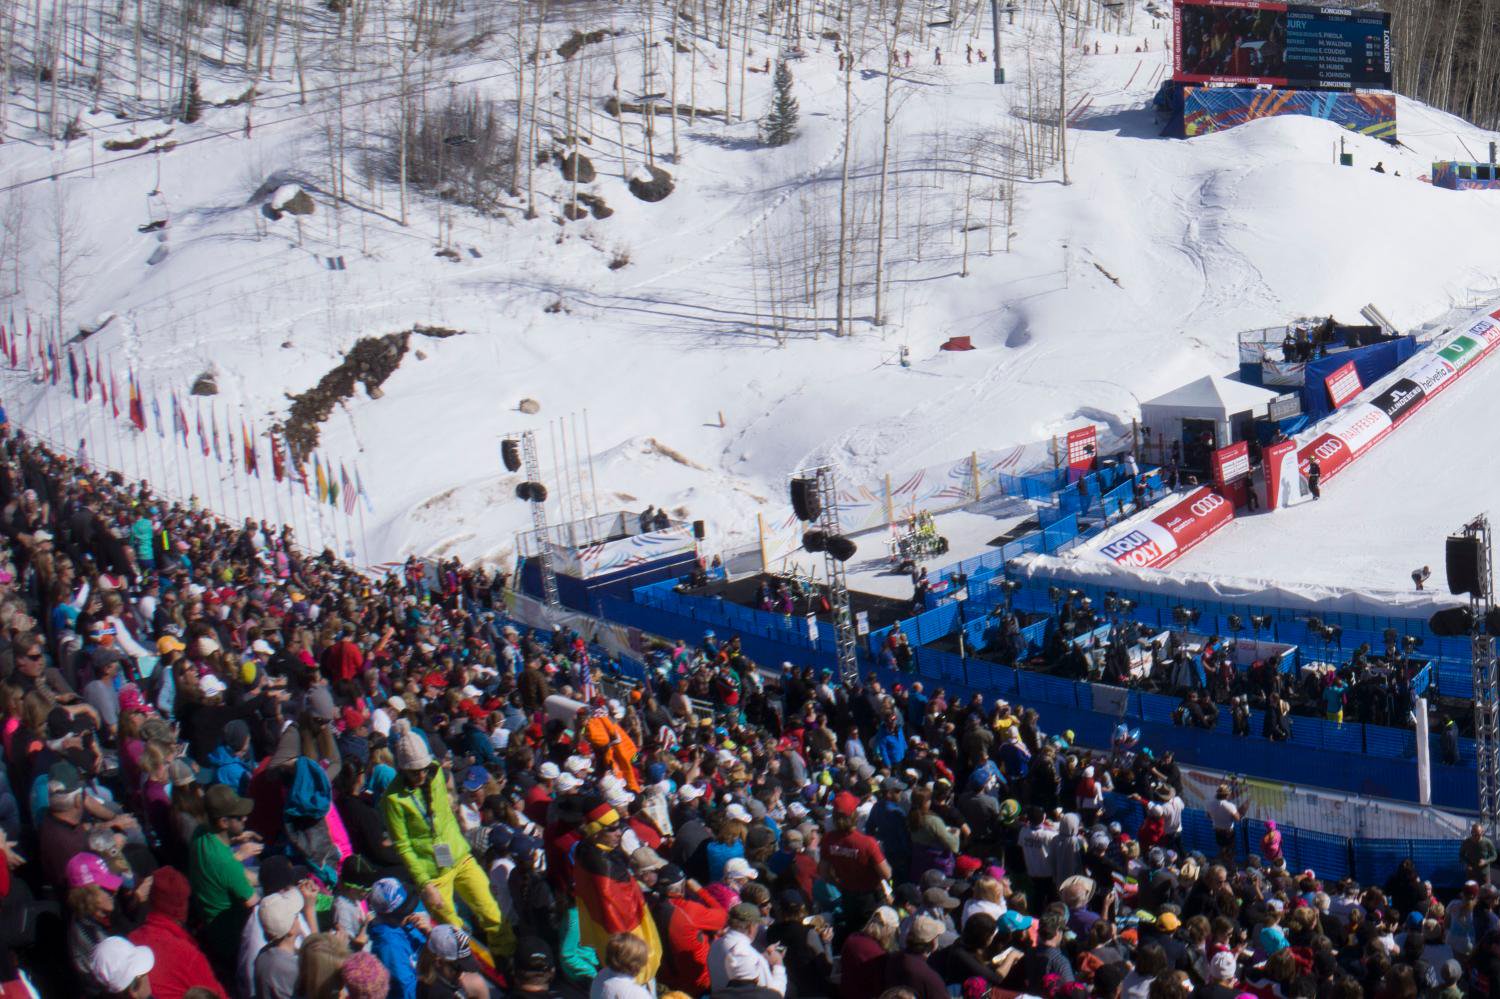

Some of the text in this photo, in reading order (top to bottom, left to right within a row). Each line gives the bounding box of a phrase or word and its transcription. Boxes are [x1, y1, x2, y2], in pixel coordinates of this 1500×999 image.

[1320, 7, 1352, 16] LONGINES
[1287, 20, 1307, 29] JURY
[1422, 367, 1447, 391] helvetia
[1340, 410, 1384, 440] RAIFFEISEN
[1165, 516, 1182, 529] Audi
[1173, 516, 1196, 534] quattro
[1101, 530, 1149, 559] LIQUI
[1118, 540, 1160, 568] MOLY
